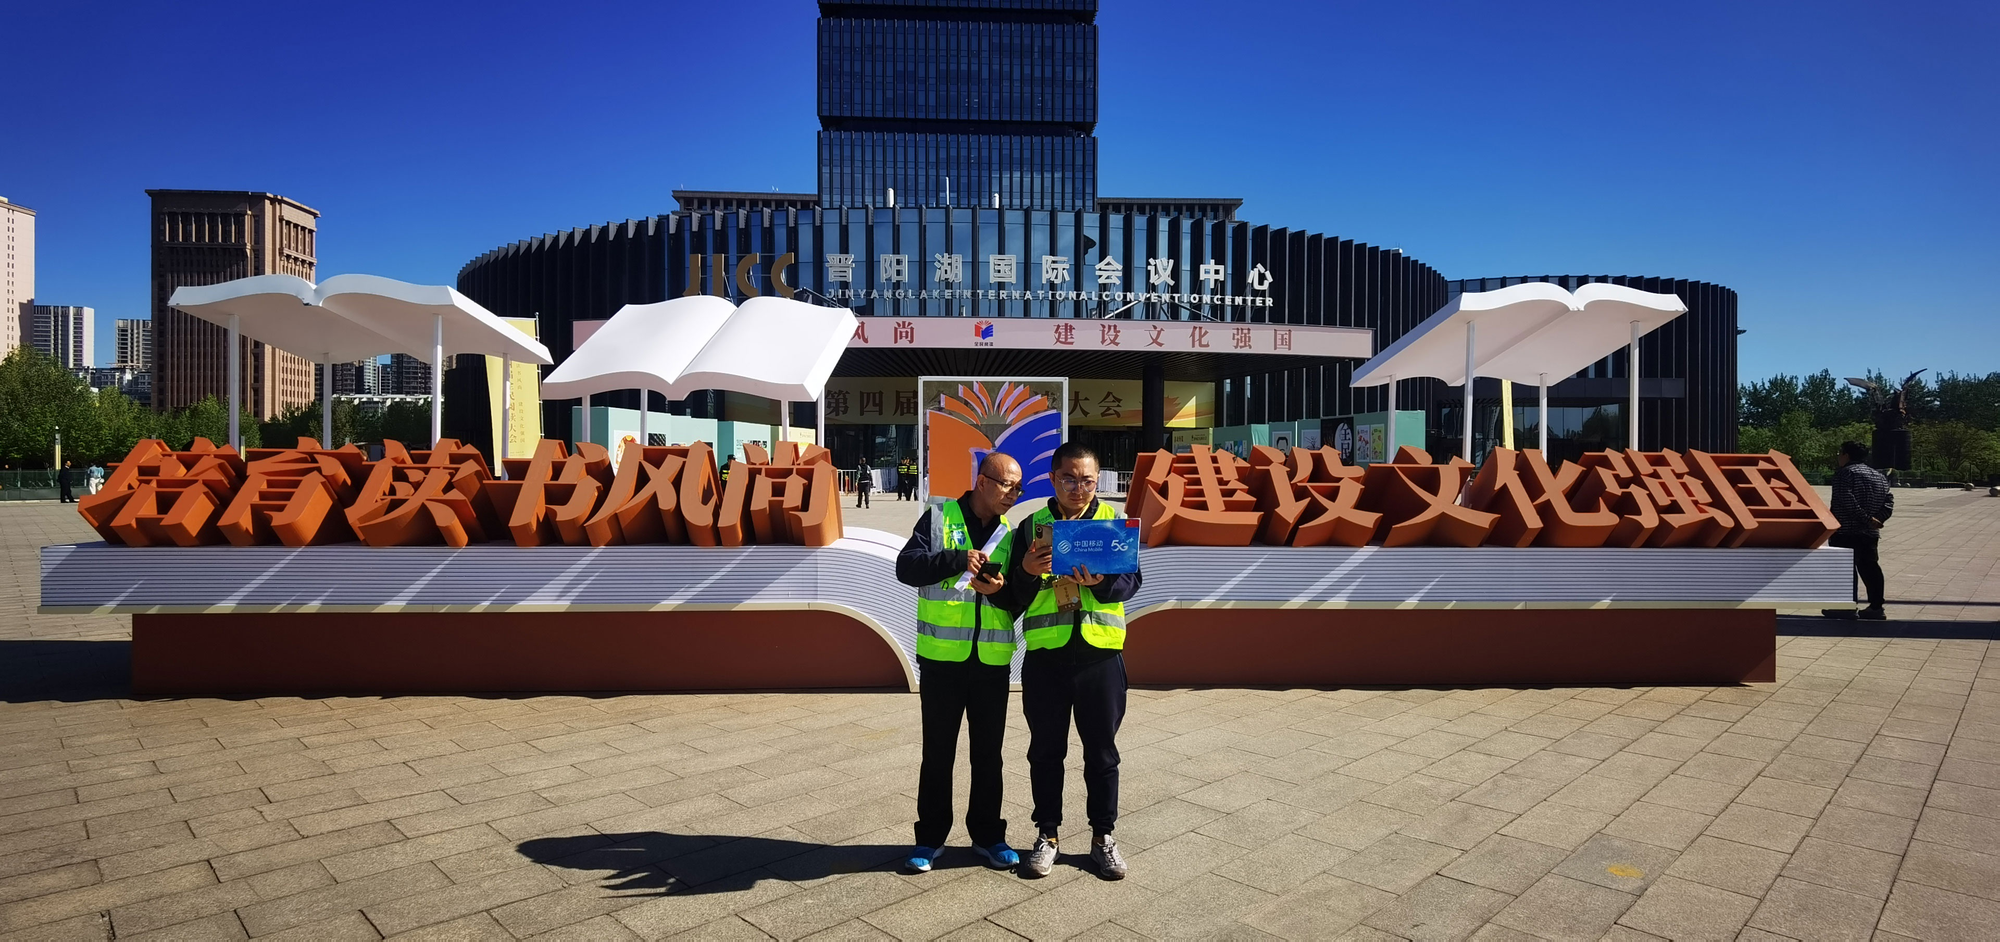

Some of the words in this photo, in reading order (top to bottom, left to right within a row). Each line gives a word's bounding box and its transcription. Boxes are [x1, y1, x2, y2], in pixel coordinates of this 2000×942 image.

[682, 252, 794, 298] JICC
[825, 253, 1273, 290] 晋阳湖国际会议中心
[1053, 322, 1292, 351] 建设文化强国
[78, 437, 843, 547] 培育读书风尚
[1134, 445, 1842, 546] 建设文化强国
[1111, 540, 1128, 551] 5G
